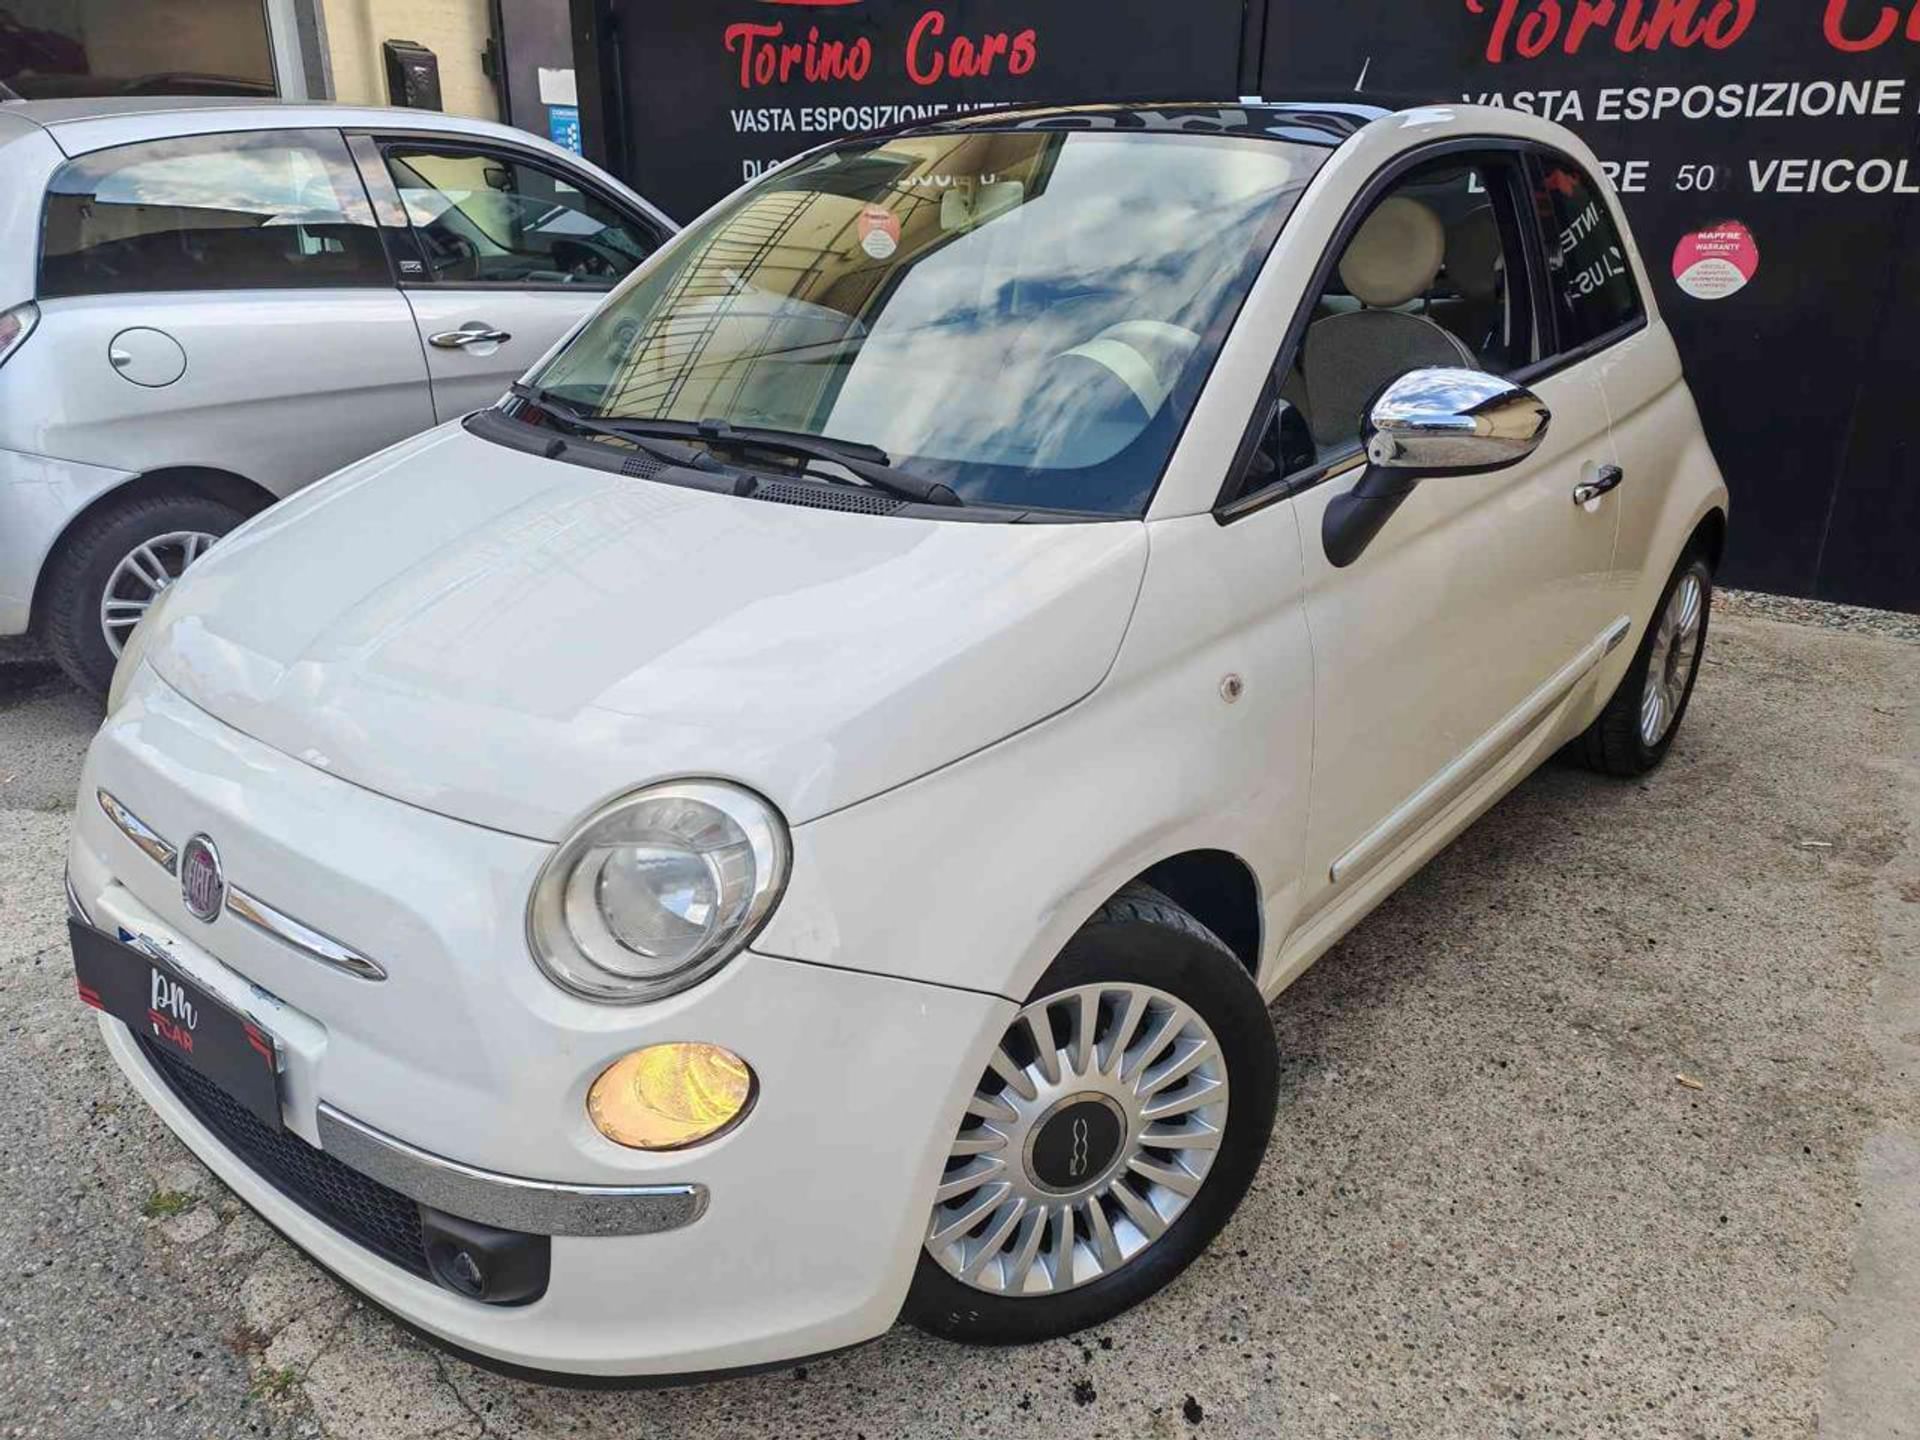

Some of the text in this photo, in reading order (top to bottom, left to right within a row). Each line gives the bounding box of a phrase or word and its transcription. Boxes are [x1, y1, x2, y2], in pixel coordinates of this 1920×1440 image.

[724, 10, 1036, 88] Torino Cars
[1596, 79, 1905, 121] ESPOSIZIONE
[730, 109, 796, 132] VASTA
[1675, 164, 1715, 190] 50
[1695, 242, 1741, 252] WARRANTY
